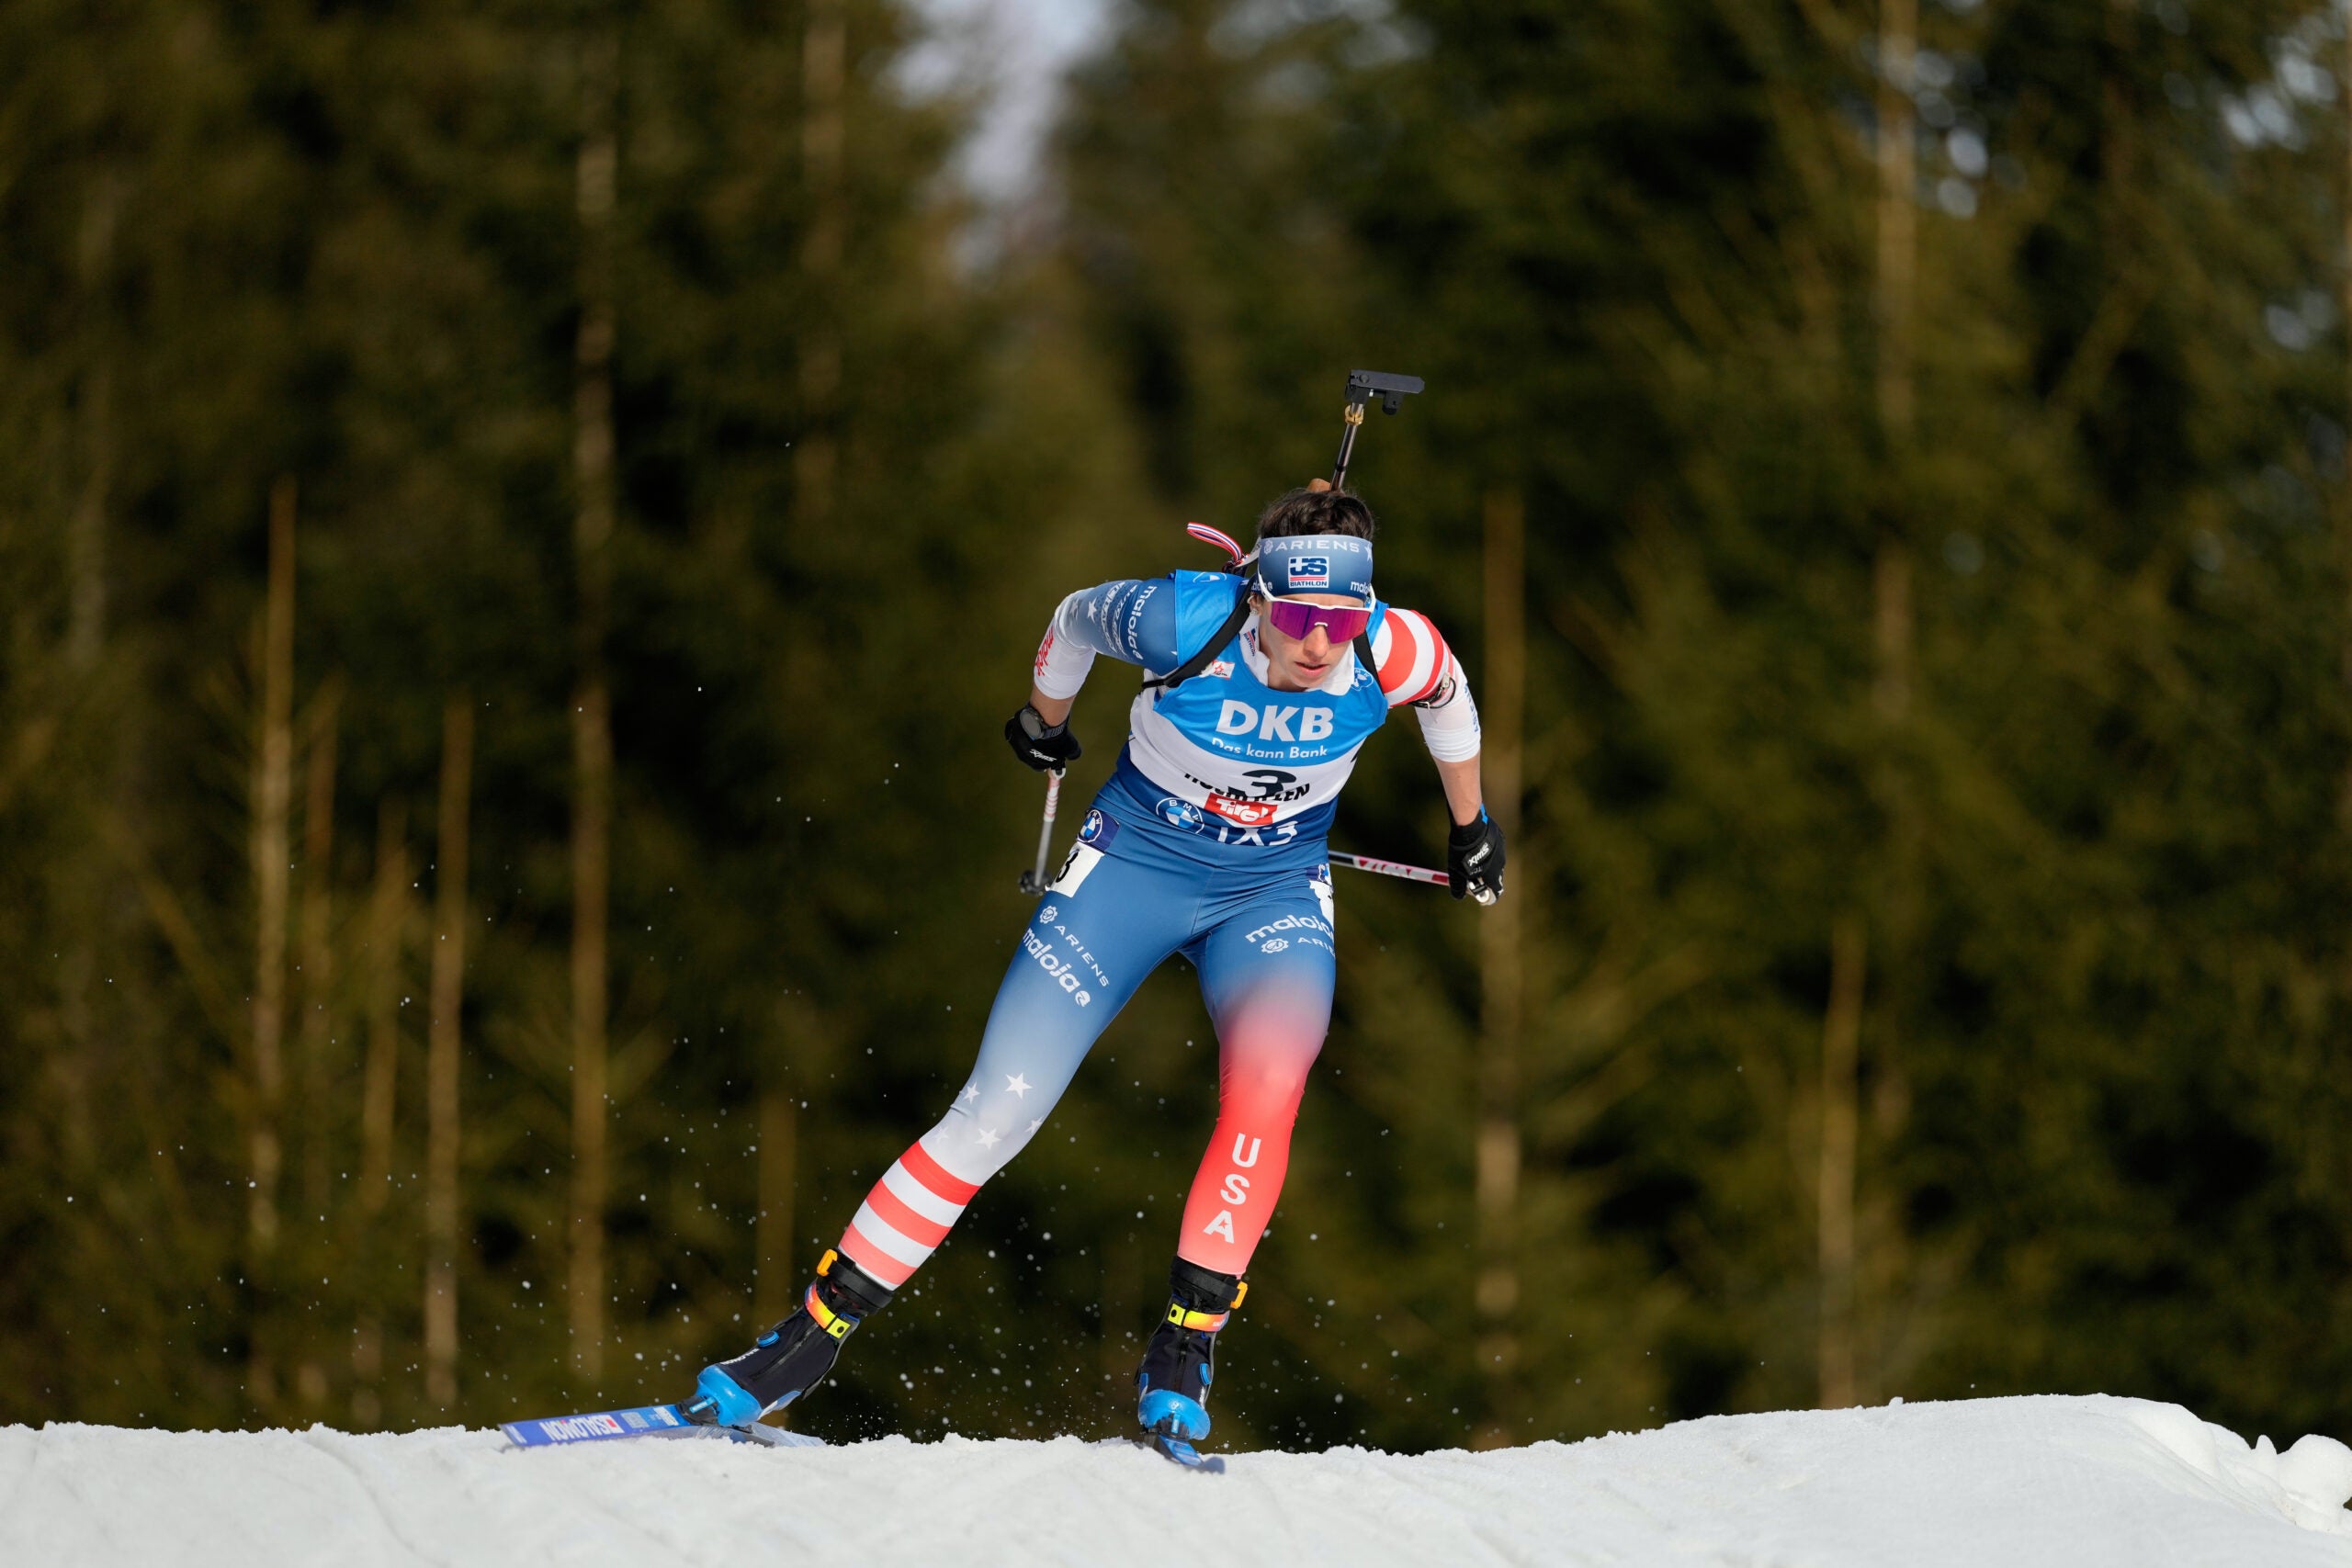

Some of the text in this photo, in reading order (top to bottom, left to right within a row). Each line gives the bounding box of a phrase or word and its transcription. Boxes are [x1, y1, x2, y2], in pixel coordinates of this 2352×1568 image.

[1275, 539, 1360, 553] ARIENS
[1290, 558, 1328, 576] US
[1127, 585, 1158, 649] maloja
[1216, 699, 1334, 742] DKB
[1212, 737, 1328, 759] Das kann Bank
[1227, 769, 1297, 798] 3
[1245, 914, 1334, 943] maloja
[1023, 928, 1081, 994] maloja
[1054, 925, 1110, 987] ARIENS
[1203, 1133, 1261, 1244] USA
[539, 1415, 611, 1440] SALOMON
